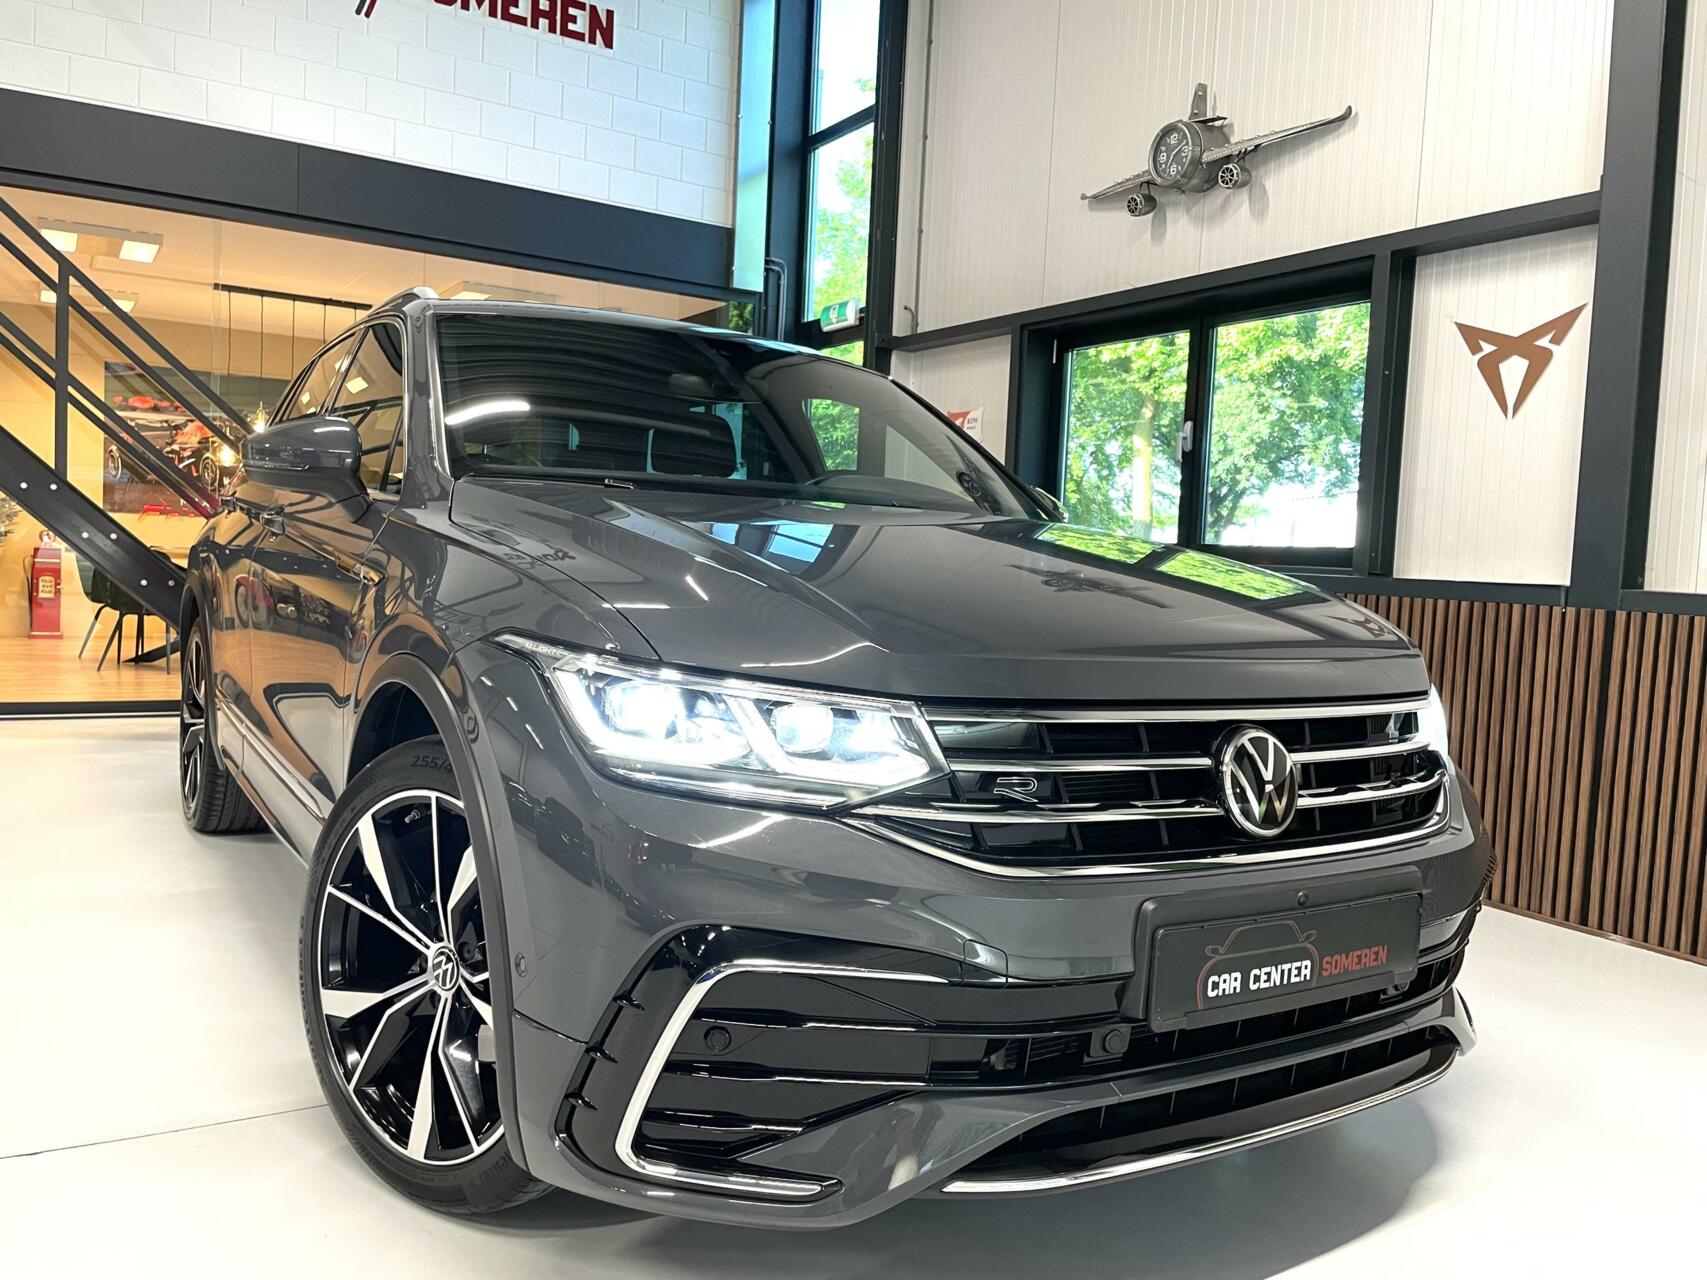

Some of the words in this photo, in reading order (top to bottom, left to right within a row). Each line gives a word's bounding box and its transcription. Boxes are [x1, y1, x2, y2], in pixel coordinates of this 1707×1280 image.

[433, 0, 615, 50] EREN
[1170, 133, 1178, 144] 12
[1181, 145, 1188, 156] 3
[1160, 152, 1167, 163] 9
[1170, 164, 1177, 175] 6
[1207, 972, 1242, 998] CAR
[1249, 960, 1312, 991] CENTER
[1321, 945, 1388, 978] SOMEREN
